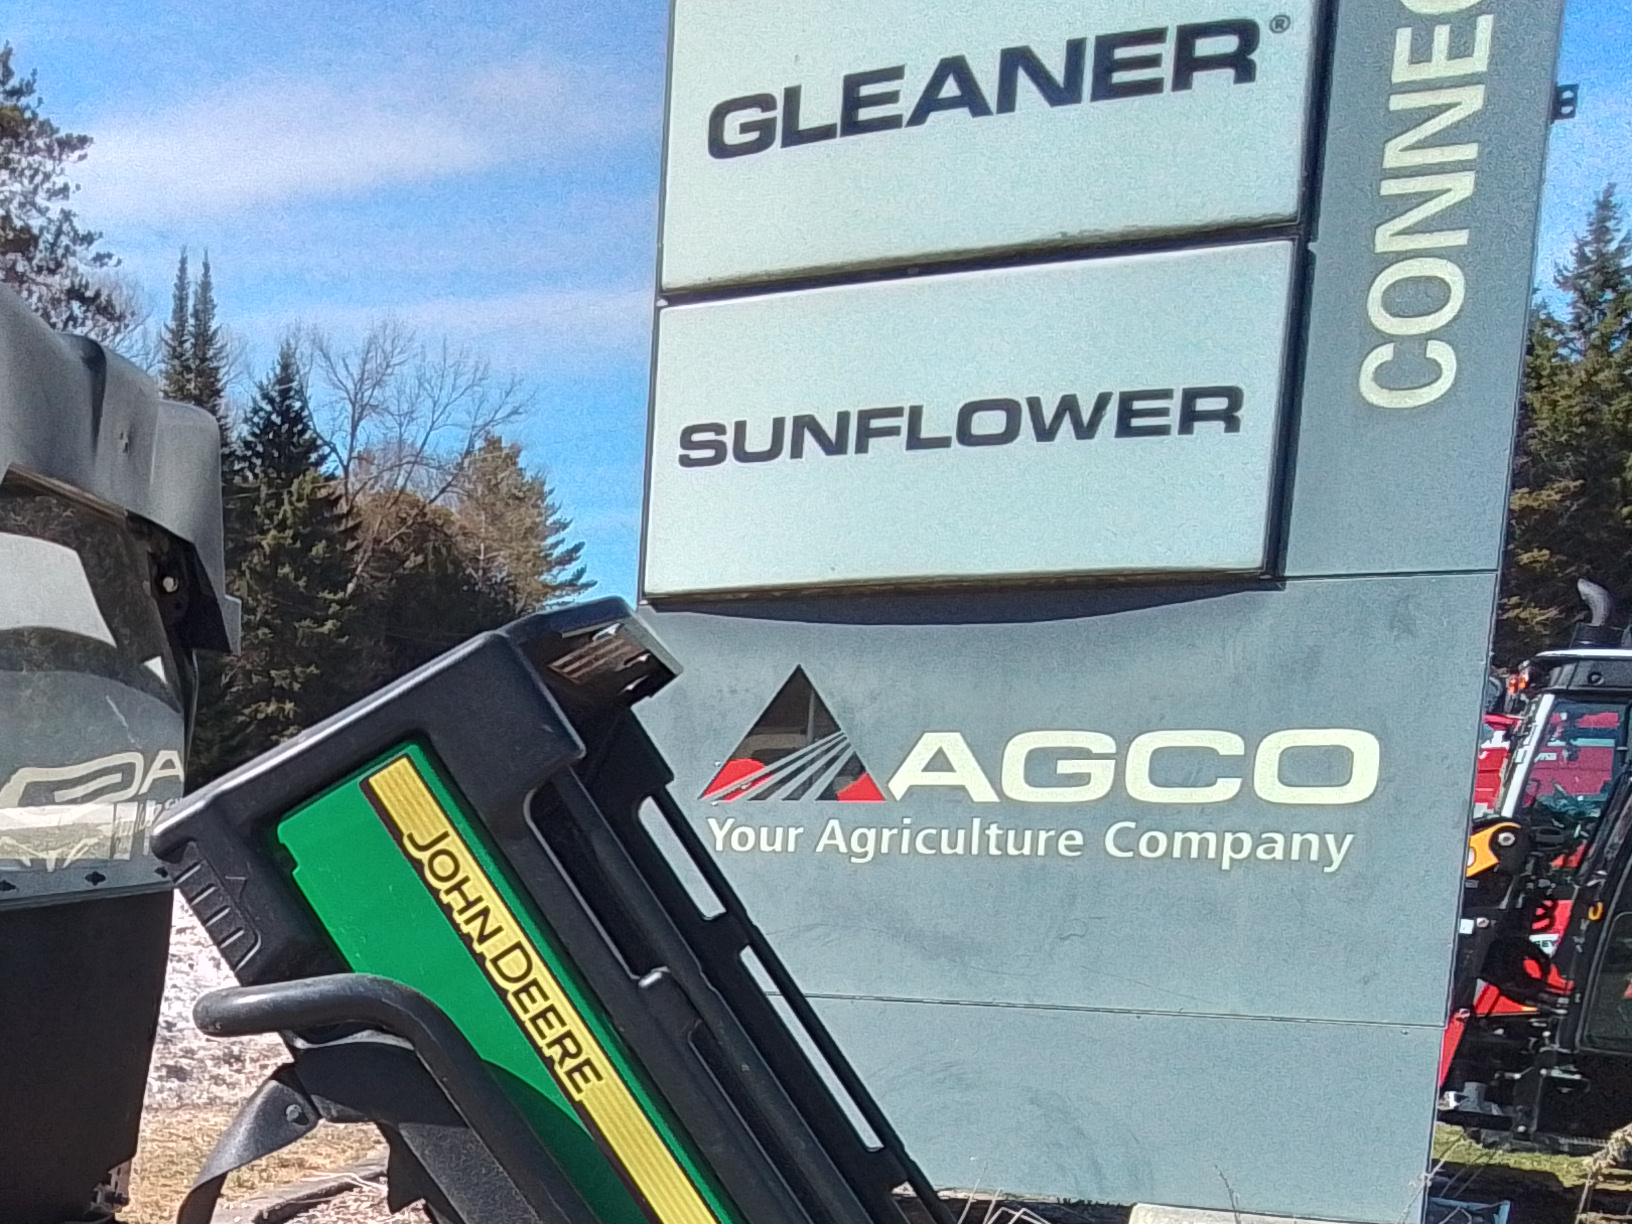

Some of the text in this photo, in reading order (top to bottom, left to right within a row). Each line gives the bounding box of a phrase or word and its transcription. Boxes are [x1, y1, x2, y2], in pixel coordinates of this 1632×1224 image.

[708, 19, 1260, 159] GLEANER
[1358, 0, 1495, 410] CONNE
[677, 385, 1244, 469] SUNFLOWER
[888, 727, 1381, 805] AGCO
[707, 817, 1354, 873] Your Agriculture Company
[407, 830, 603, 1095] JOHN DEERE
